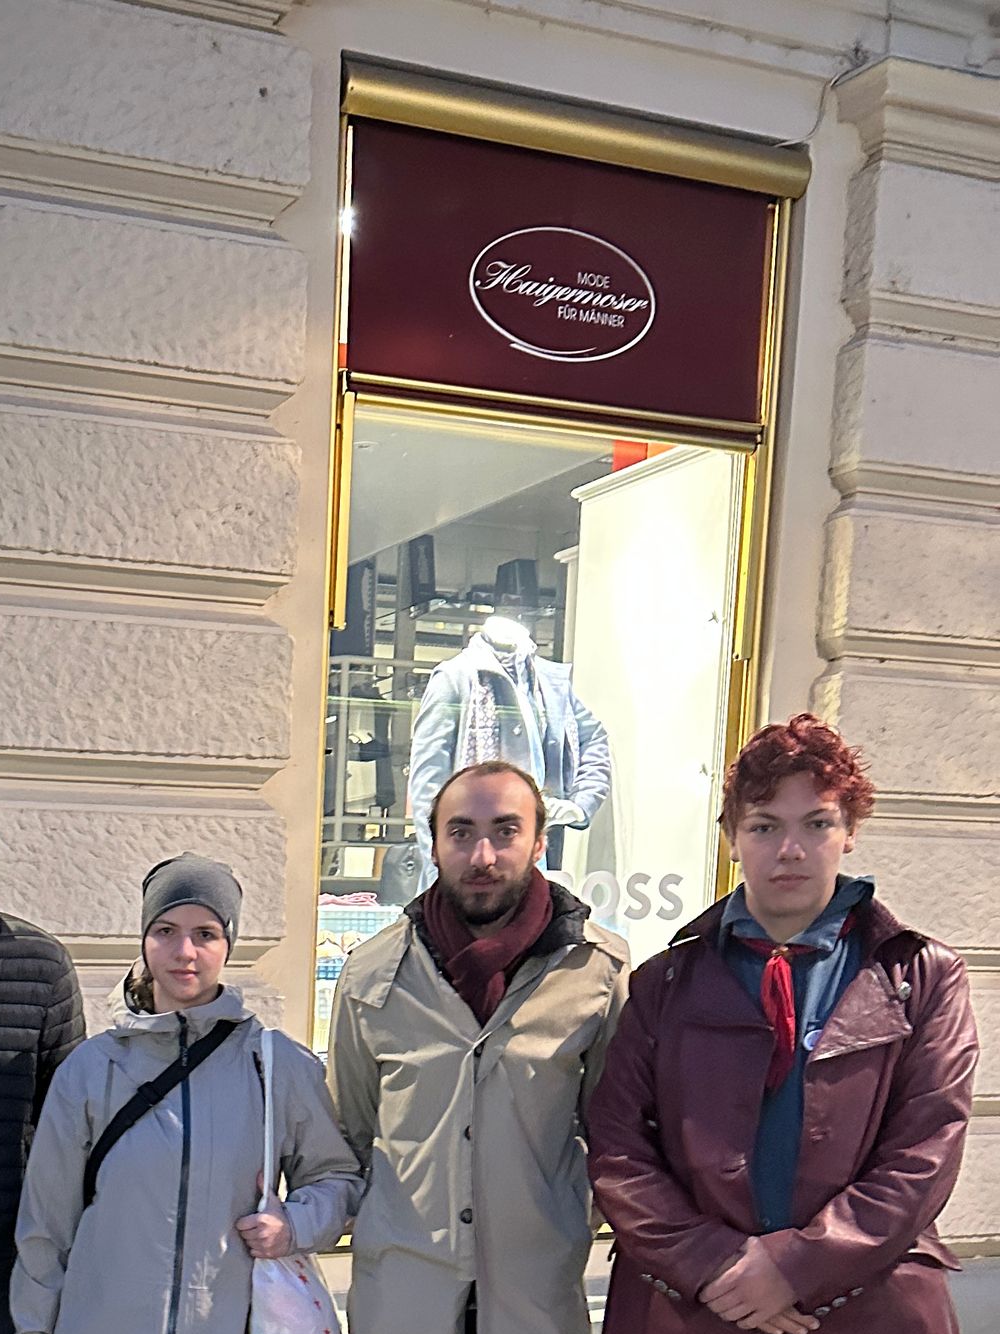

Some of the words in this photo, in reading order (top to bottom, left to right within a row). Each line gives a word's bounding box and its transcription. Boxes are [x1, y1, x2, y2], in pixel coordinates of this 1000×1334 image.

[474, 260, 650, 313] Haigermoser
[577, 271, 611, 288] MODE
[557, 304, 577, 320] FÜR
[579, 310, 625, 328] MÄNNER
[546, 870, 684, 921] OSS
